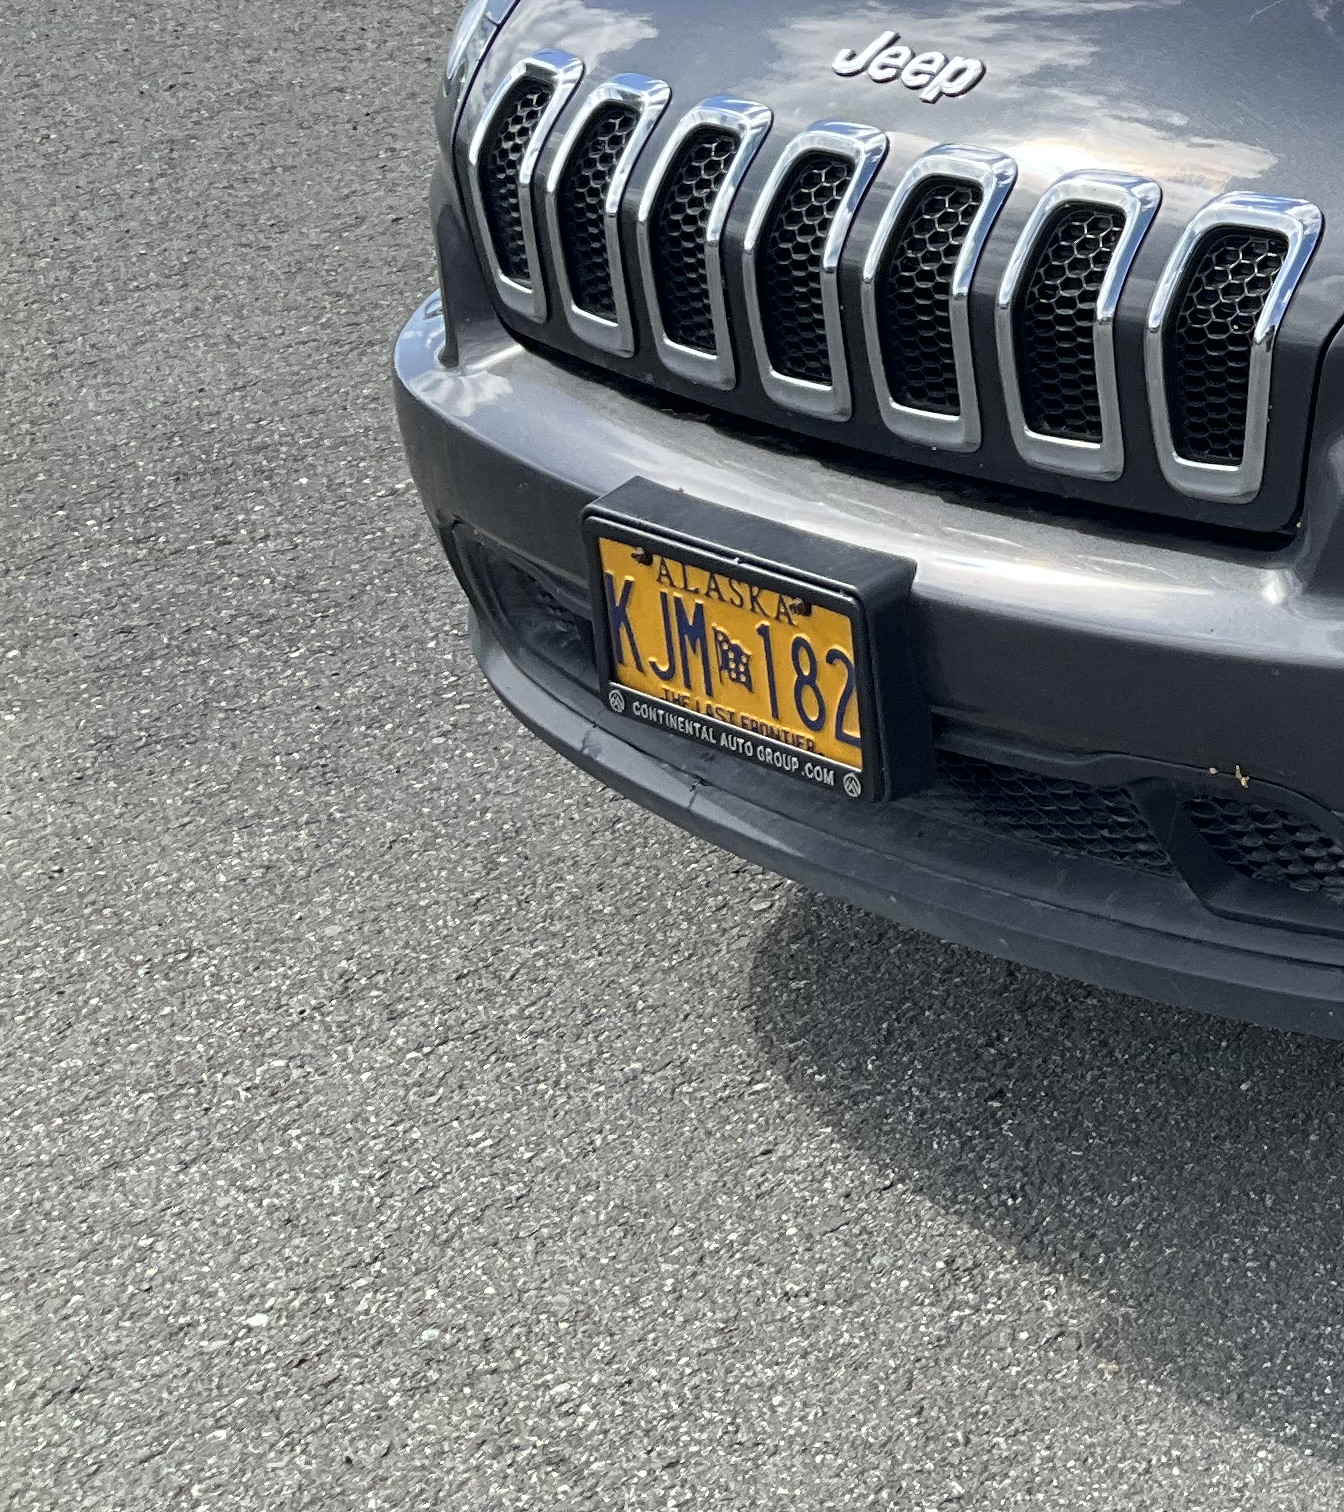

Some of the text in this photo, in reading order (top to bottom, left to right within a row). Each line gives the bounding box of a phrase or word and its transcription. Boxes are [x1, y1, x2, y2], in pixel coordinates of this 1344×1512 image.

[831, 30, 987, 104] Jeep
[655, 556, 799, 627] ALASKA
[631, 700, 717, 745] CONTINENTAL
[720, 733, 754, 758] AUTO
